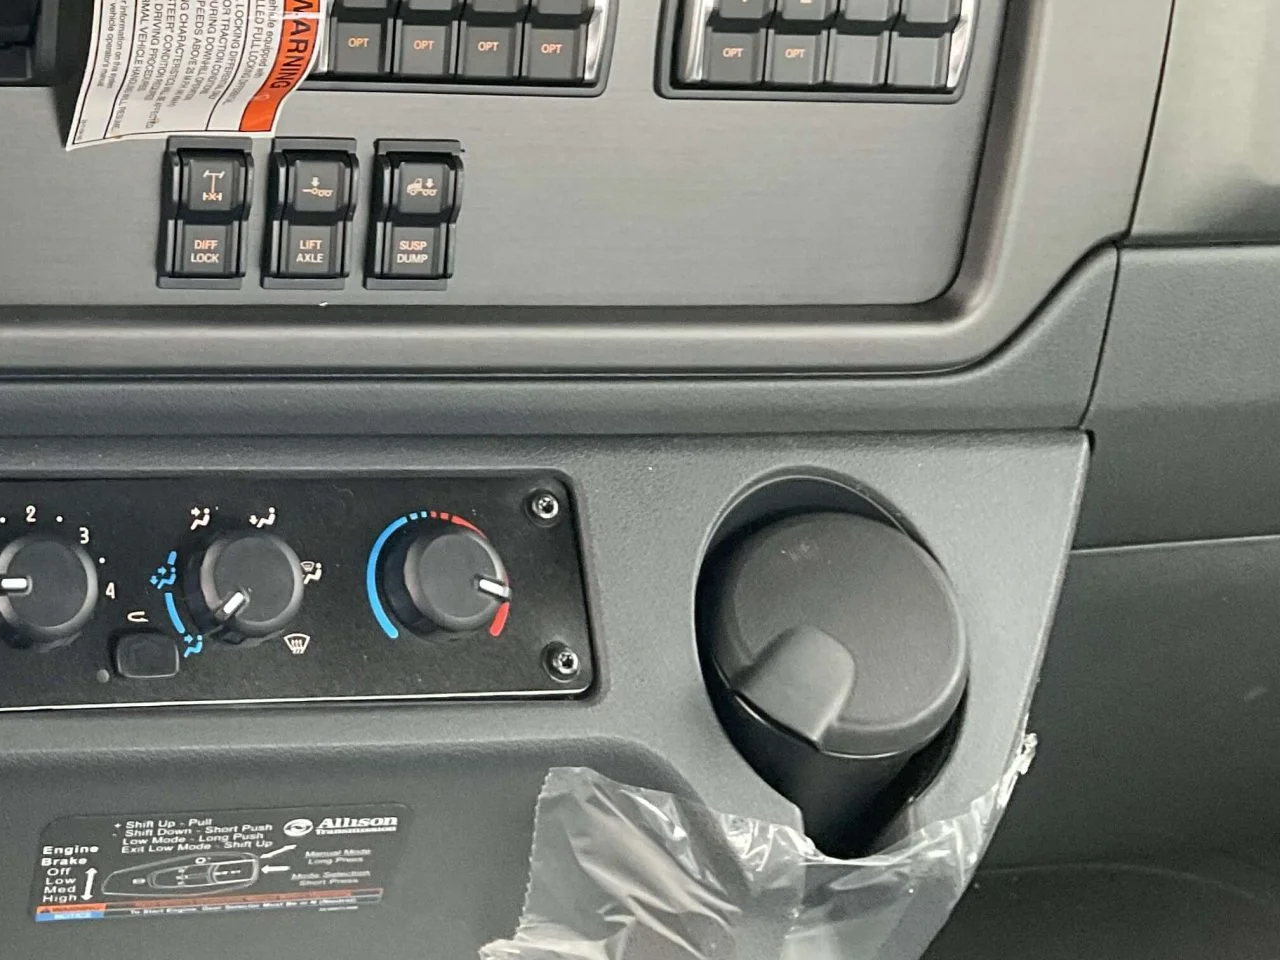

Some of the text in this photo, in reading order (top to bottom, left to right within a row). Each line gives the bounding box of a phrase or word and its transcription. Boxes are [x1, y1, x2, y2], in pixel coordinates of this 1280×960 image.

[109, 3, 118, 31] vehicle
[118, 5, 128, 48] information
[151, 3, 163, 45] DRIVING
[232, 5, 244, 48] LOCKING
[215, 19, 230, 62] TRACTION
[252, 27, 264, 48] FULL
[347, 37, 369, 48] OPT
[134, 27, 148, 64] VEHICLE
[258, 32, 274, 66] equipped
[413, 40, 434, 51] OPT
[477, 41, 499, 52] OPT
[540, 44, 562, 54] OPT
[156, 35, 174, 78] CONDITION
[189, 38, 203, 66] ABOVE
[197, 37, 216, 76] DOWNHILL
[722, 47, 744, 58] OPT
[785, 48, 806, 59] OPT
[241, 51, 259, 78] LOCKING
[194, 240, 218, 250] DIFF
[299, 240, 323, 250] LIFT
[399, 240, 427, 251] SUSP
[190, 253, 219, 264] LOCK
[296, 253, 324, 263] AXLE
[397, 253, 428, 264] DUMP
[26, 505, 36, 523] 2
[79, 527, 90, 544] 3
[105, 582, 116, 599] 4
[126, 818, 212, 829] Shift Up Pull
[318, 817, 397, 828] Allison
[125, 824, 273, 837] Shift Down Short Push
[152, 836, 186, 844] Mode
[199, 835, 229, 843] Long
[43, 845, 99, 856] Engine
[122, 846, 145, 854] Exit
[178, 843, 211, 851] Mode
[224, 841, 252, 849] Shift
[256, 840, 273, 848] Up
[41, 857, 87, 866] Brake
[47, 867, 71, 876] Off
[44, 885, 76, 893] Med
[42, 895, 77, 903] High
